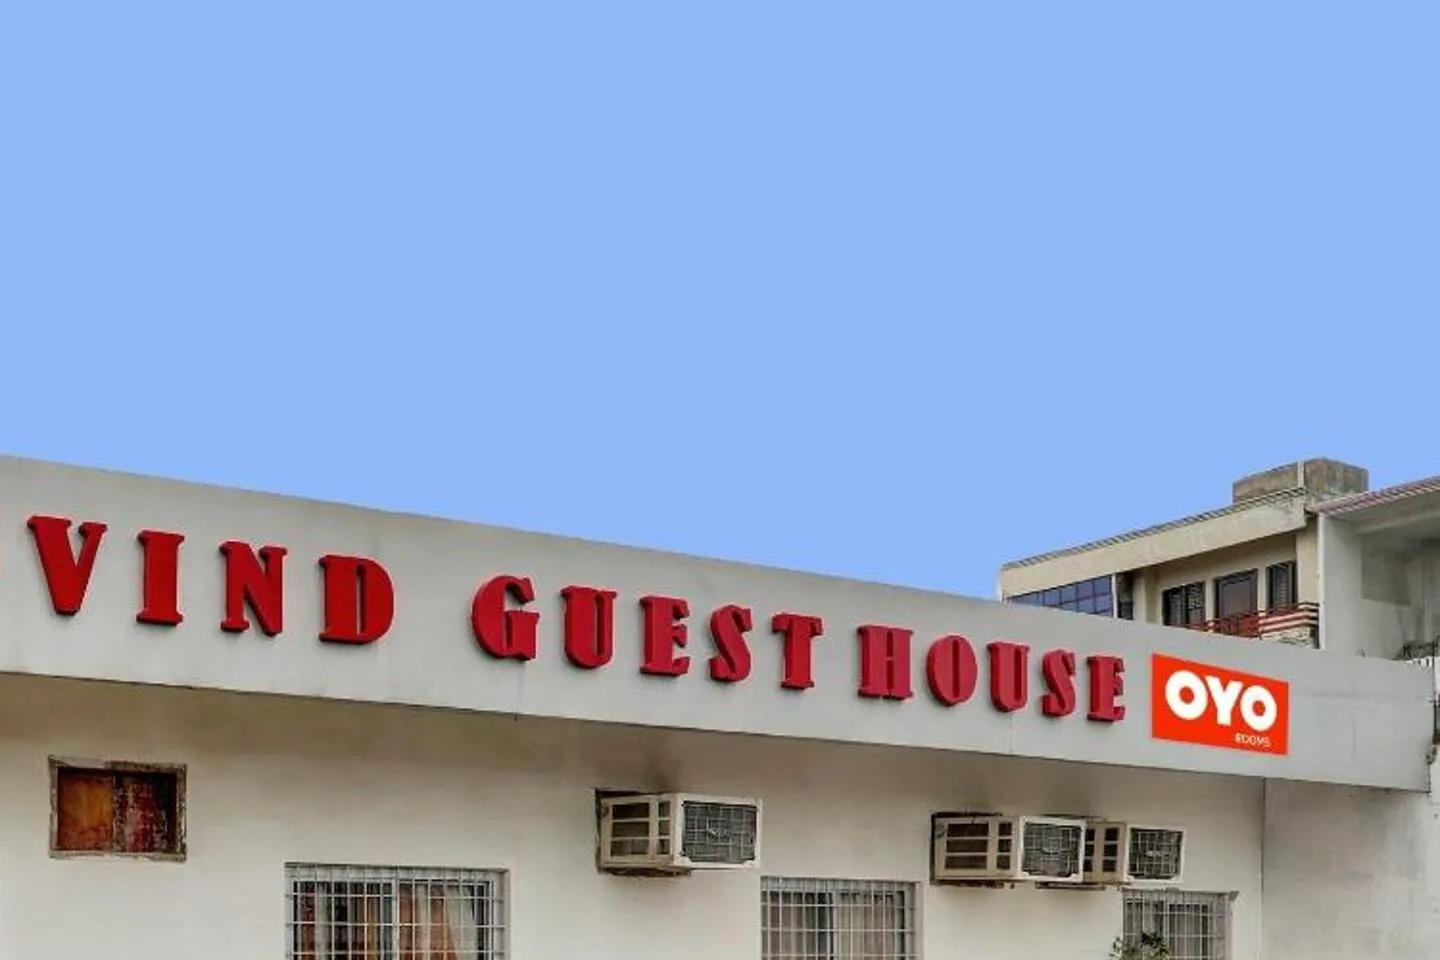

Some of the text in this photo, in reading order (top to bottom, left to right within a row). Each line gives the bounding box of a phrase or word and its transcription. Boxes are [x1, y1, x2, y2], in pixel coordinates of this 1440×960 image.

[471, 575, 823, 691] GUEST
[858, 625, 1127, 722] HOUSE
[1165, 670, 1277, 732] OYO
[1235, 732, 1272, 748] ROOMS
